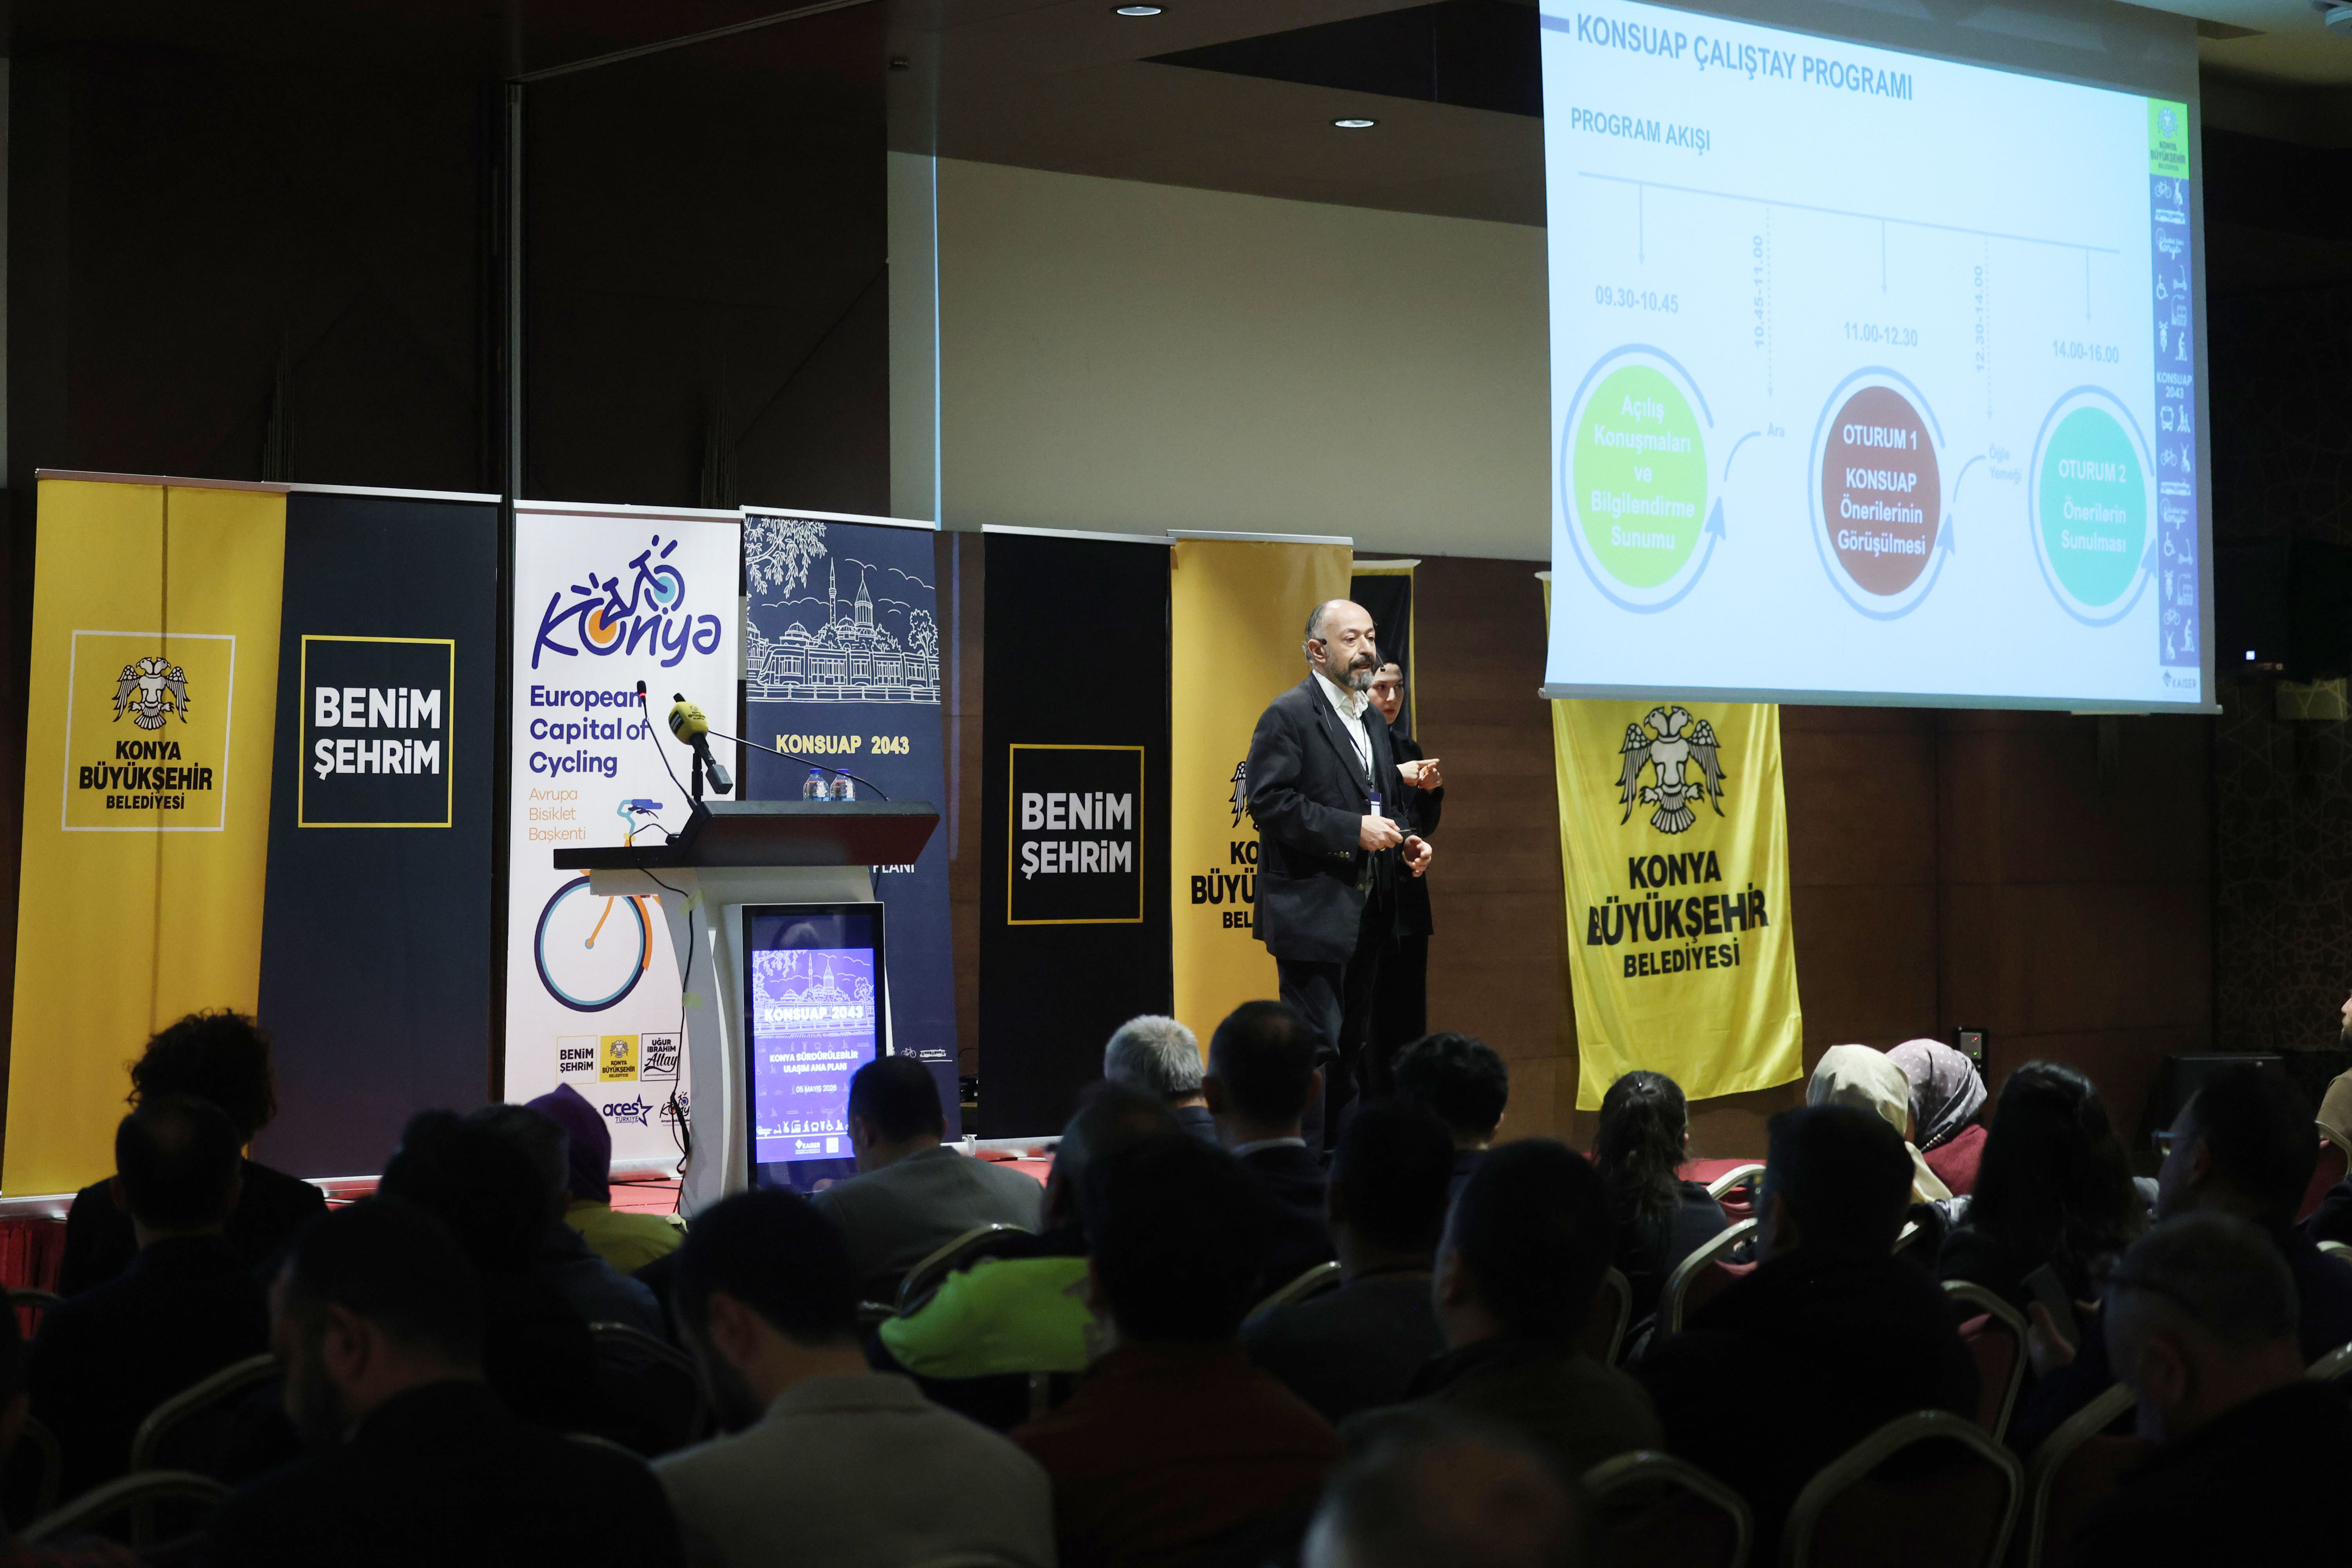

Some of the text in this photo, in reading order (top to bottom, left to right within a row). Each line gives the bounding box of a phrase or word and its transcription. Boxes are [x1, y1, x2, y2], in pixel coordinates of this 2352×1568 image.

[1578, 13, 1913, 100] KONSUAP ÇALIŞTAY PROGRAMI
[1571, 107, 1710, 155] PROGRAM AKIŞI
[1595, 285, 1679, 313] 09.30-10.45
[1753, 235, 1763, 348] 10.45-11.00
[1975, 266, 1985, 372] 12.30-14.00
[1844, 321, 1918, 347] 11.00-12.30
[2053, 340, 2120, 364] 14.00-16.00
[2156, 372, 2192, 387] KONSUAP
[2165, 386, 2184, 399] 2043
[1621, 395, 1665, 424] Açılış
[1594, 425, 1691, 454] Konuşmaları
[1767, 422, 1785, 438] Ara
[1843, 424, 1918, 450] OTURUM 1
[1634, 465, 1653, 482] ve
[1846, 467, 1917, 493] KONSUAP
[2059, 459, 2127, 483] OTURUM 2
[1591, 490, 1695, 519] Bilgilendirme
[1840, 493, 1923, 524] Önerilerinin
[2064, 495, 2127, 524] Önerilerin
[1611, 525, 1675, 550] Sunumu
[1837, 530, 1926, 557] Görüşülmesi
[2061, 530, 2127, 553] Sunulması
[532, 570, 722, 670] Konya
[530, 685, 643, 711] European
[530, 717, 650, 744] Capital of
[115, 740, 181, 760] KONYA
[776, 734, 910, 755] KONSUAP 2043
[529, 750, 618, 778] Cycling
[79, 762, 212, 793] BÜYÜKŞEHİR
[105, 792, 185, 810] BELEDİYESİ
[529, 788, 578, 804] Avrupa
[529, 807, 576, 821] Bisiklet
[529, 827, 586, 843] Başkenti
[1629, 850, 1722, 890] KONYA
[1587, 882, 1769, 946] BÜYÜKŞEHİR
[1624, 937, 1740, 978] BELEDİYESİ
[765, 1005, 863, 1021] KONSUAP 2043
[644, 1053, 679, 1073] Altay
[769, 1050, 858, 1062] KONYA SÜRDÜRÜLEBİLİR
[783, 1064, 809, 1074] ULAŞIM
[810, 1063, 827, 1072] ANA
[603, 1103, 639, 1116] aces
